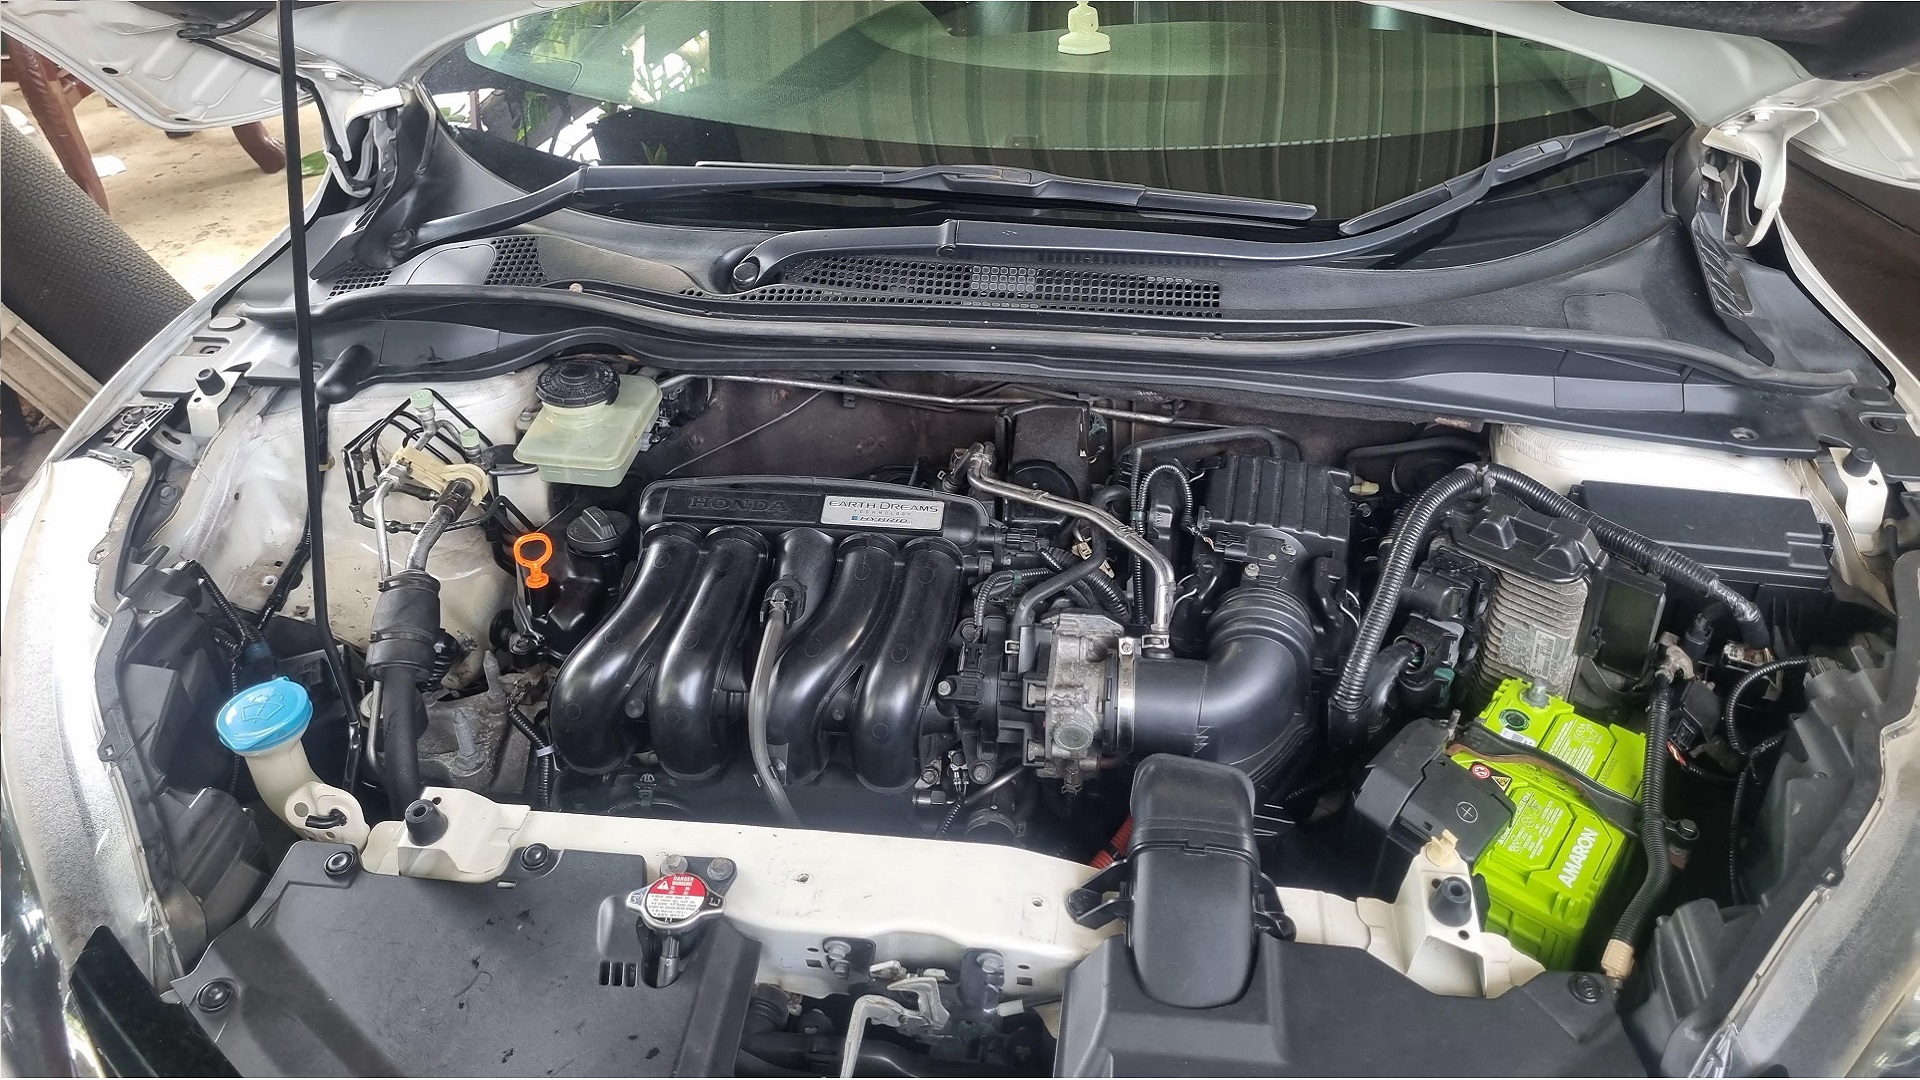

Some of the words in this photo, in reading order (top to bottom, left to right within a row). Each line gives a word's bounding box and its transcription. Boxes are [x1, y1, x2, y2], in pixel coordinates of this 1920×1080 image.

[688, 497, 790, 512] HONDA
[829, 500, 876, 509] EARTH
[880, 501, 938, 512] DREAMS
[860, 516, 908, 524] HYBRID
[1558, 827, 1599, 889] AMARON
